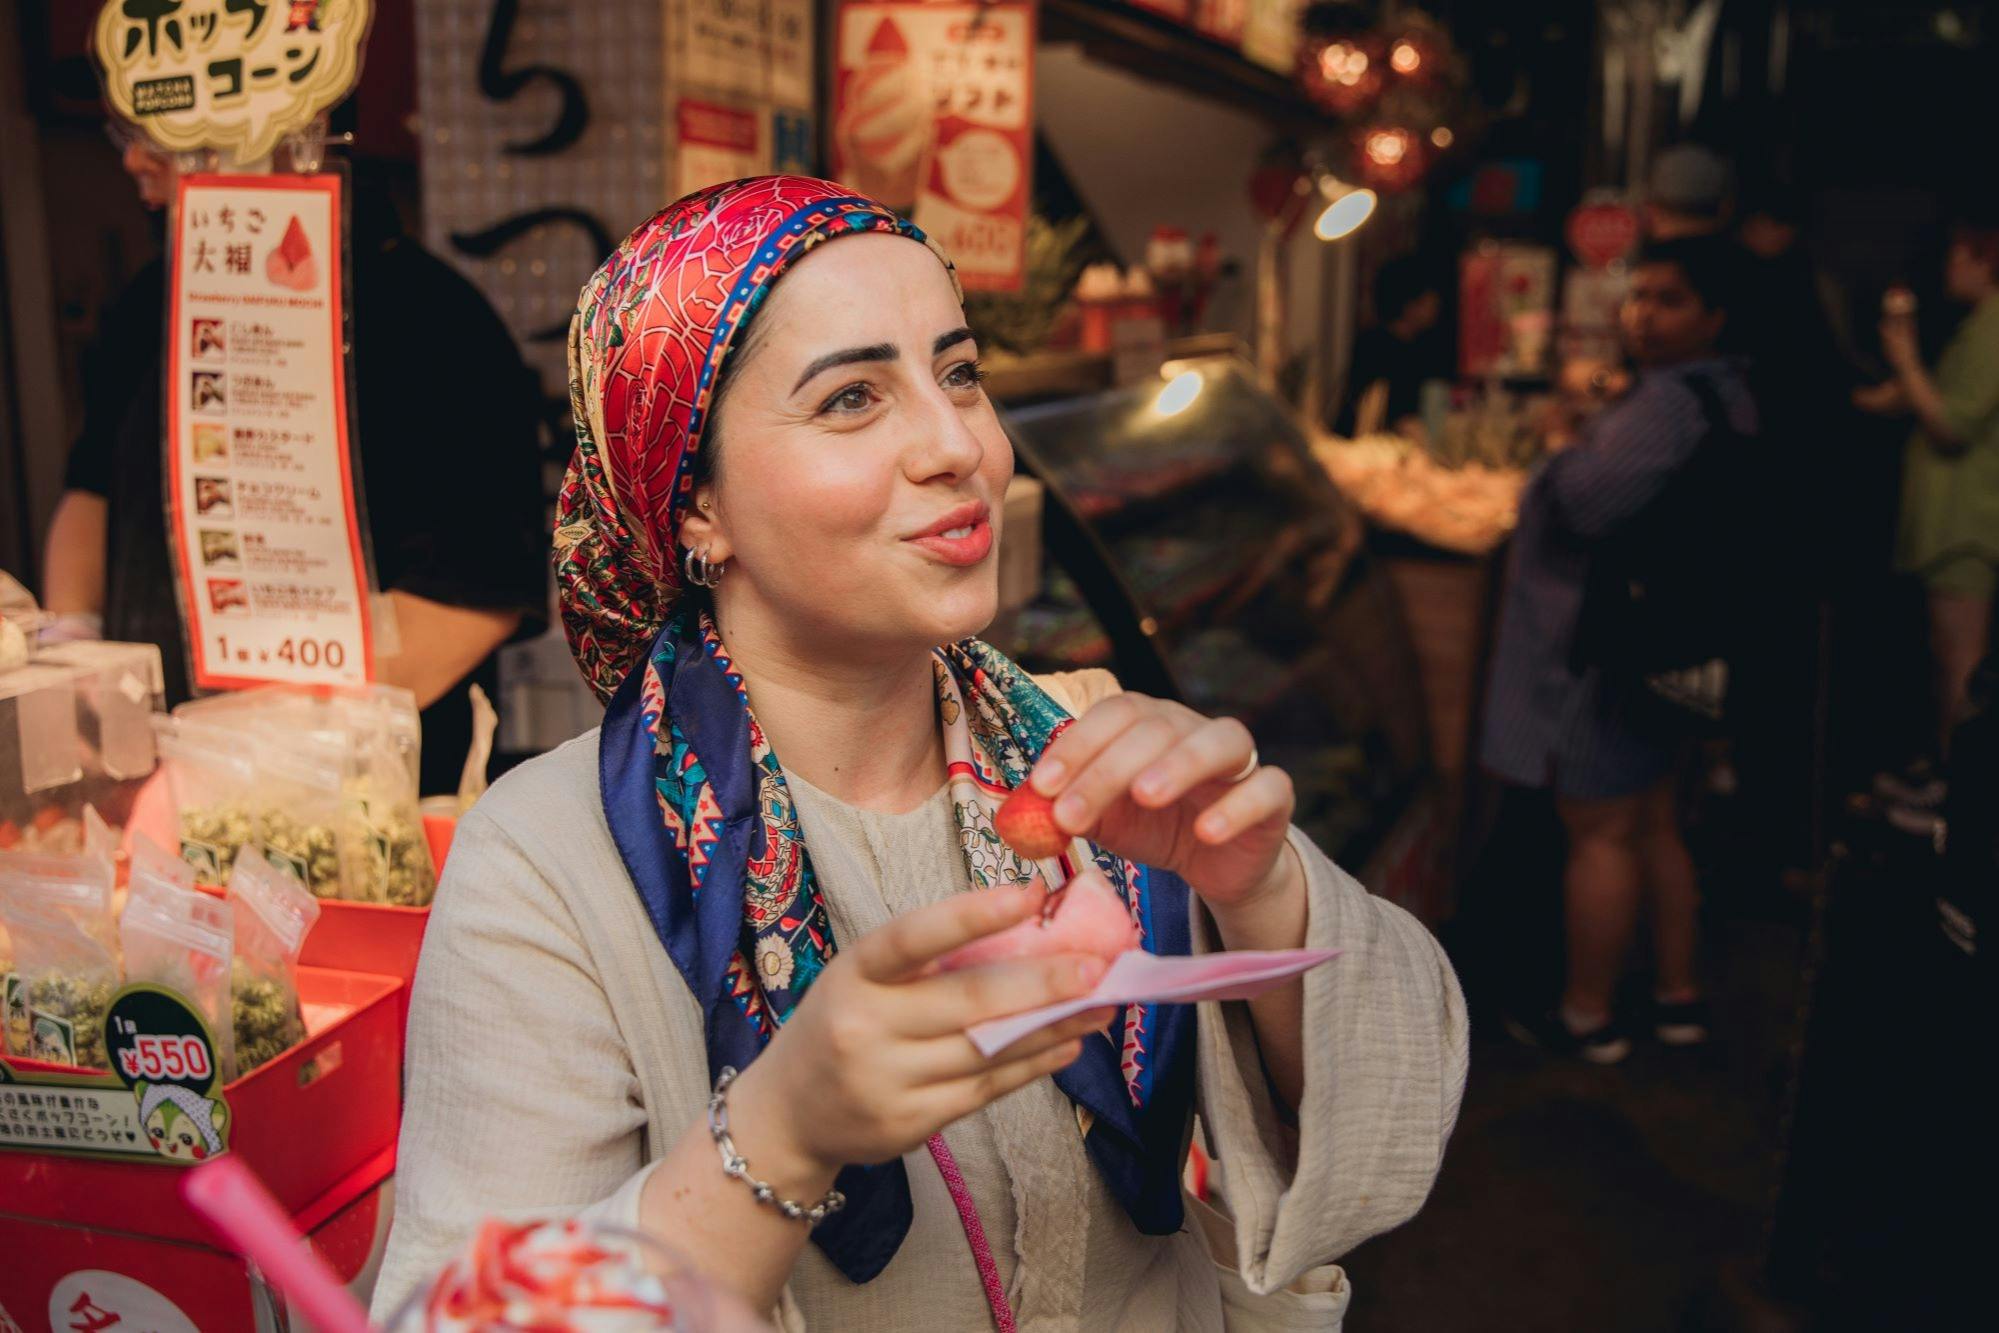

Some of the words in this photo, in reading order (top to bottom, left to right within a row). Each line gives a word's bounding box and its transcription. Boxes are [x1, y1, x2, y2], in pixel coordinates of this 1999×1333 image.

[207, 47, 321, 98] コーン
[191, 203, 267, 234] いちご
[193, 240, 252, 275] 大福
[120, 1036, 210, 1077] ¥550
[0, 1091, 100, 1111] の風味が豊かな
